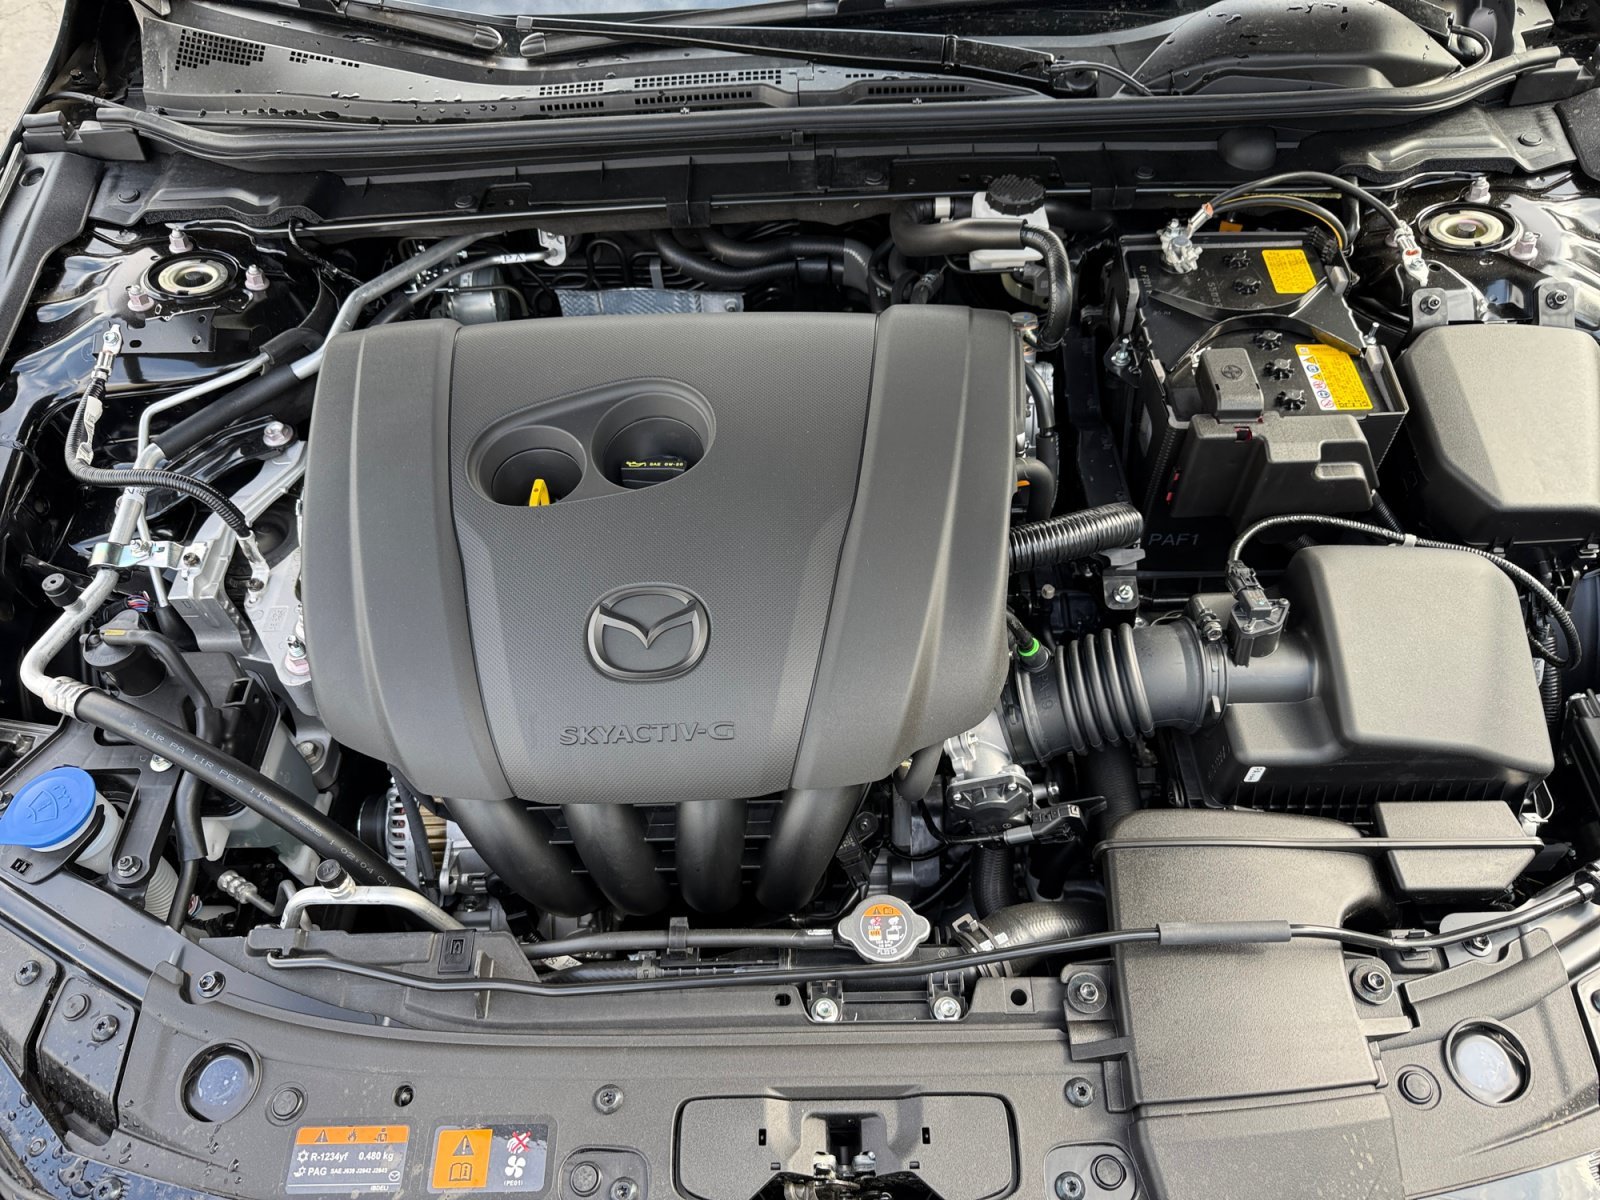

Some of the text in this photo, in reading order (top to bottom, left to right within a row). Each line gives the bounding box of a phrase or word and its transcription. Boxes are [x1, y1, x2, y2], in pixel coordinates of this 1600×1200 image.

[1148, 533, 1199, 546] PAF1
[560, 721, 735, 745] SKYACTIV-G
[218, 769, 244, 785] PET
[310, 1151, 394, 1162] R-1234yf 0.480 kg
[308, 1167, 327, 1176] PAG
